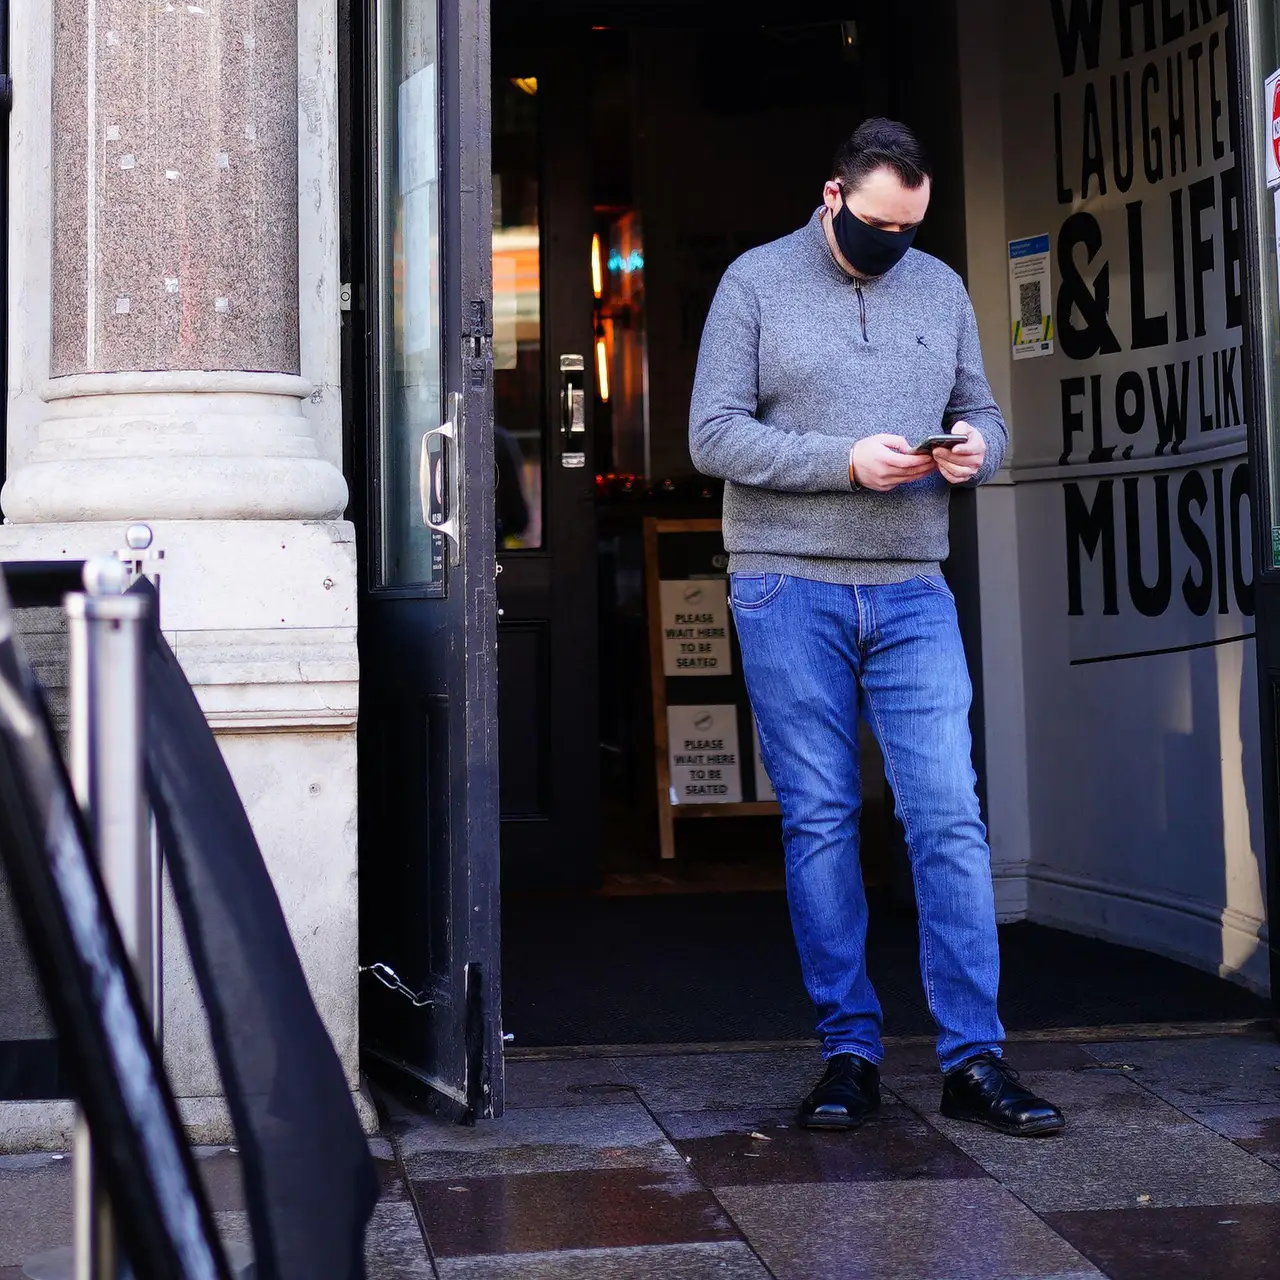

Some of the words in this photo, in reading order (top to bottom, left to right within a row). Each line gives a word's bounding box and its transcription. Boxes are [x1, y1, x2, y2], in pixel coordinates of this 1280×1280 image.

[1057, 212, 1122, 360] &
[1125, 167, 1243, 350] LIFE
[1059, 361, 1190, 466] FLOW
[1197, 346, 1247, 432] LIK
[675, 613, 713, 623] PLEASE
[665, 628, 695, 637] WAIT
[697, 628, 724, 637] HERE
[681, 643, 696, 652] TO
[699, 643, 712, 652] BE
[676, 658, 718, 667] SEATED
[684, 740, 724, 749] PLEASE
[673, 755, 704, 764] WAIT
[707, 754, 735, 764] HERE
[689, 770, 706, 779] TO
[708, 769, 722, 779] BE
[685, 785, 728, 794] SEATED
